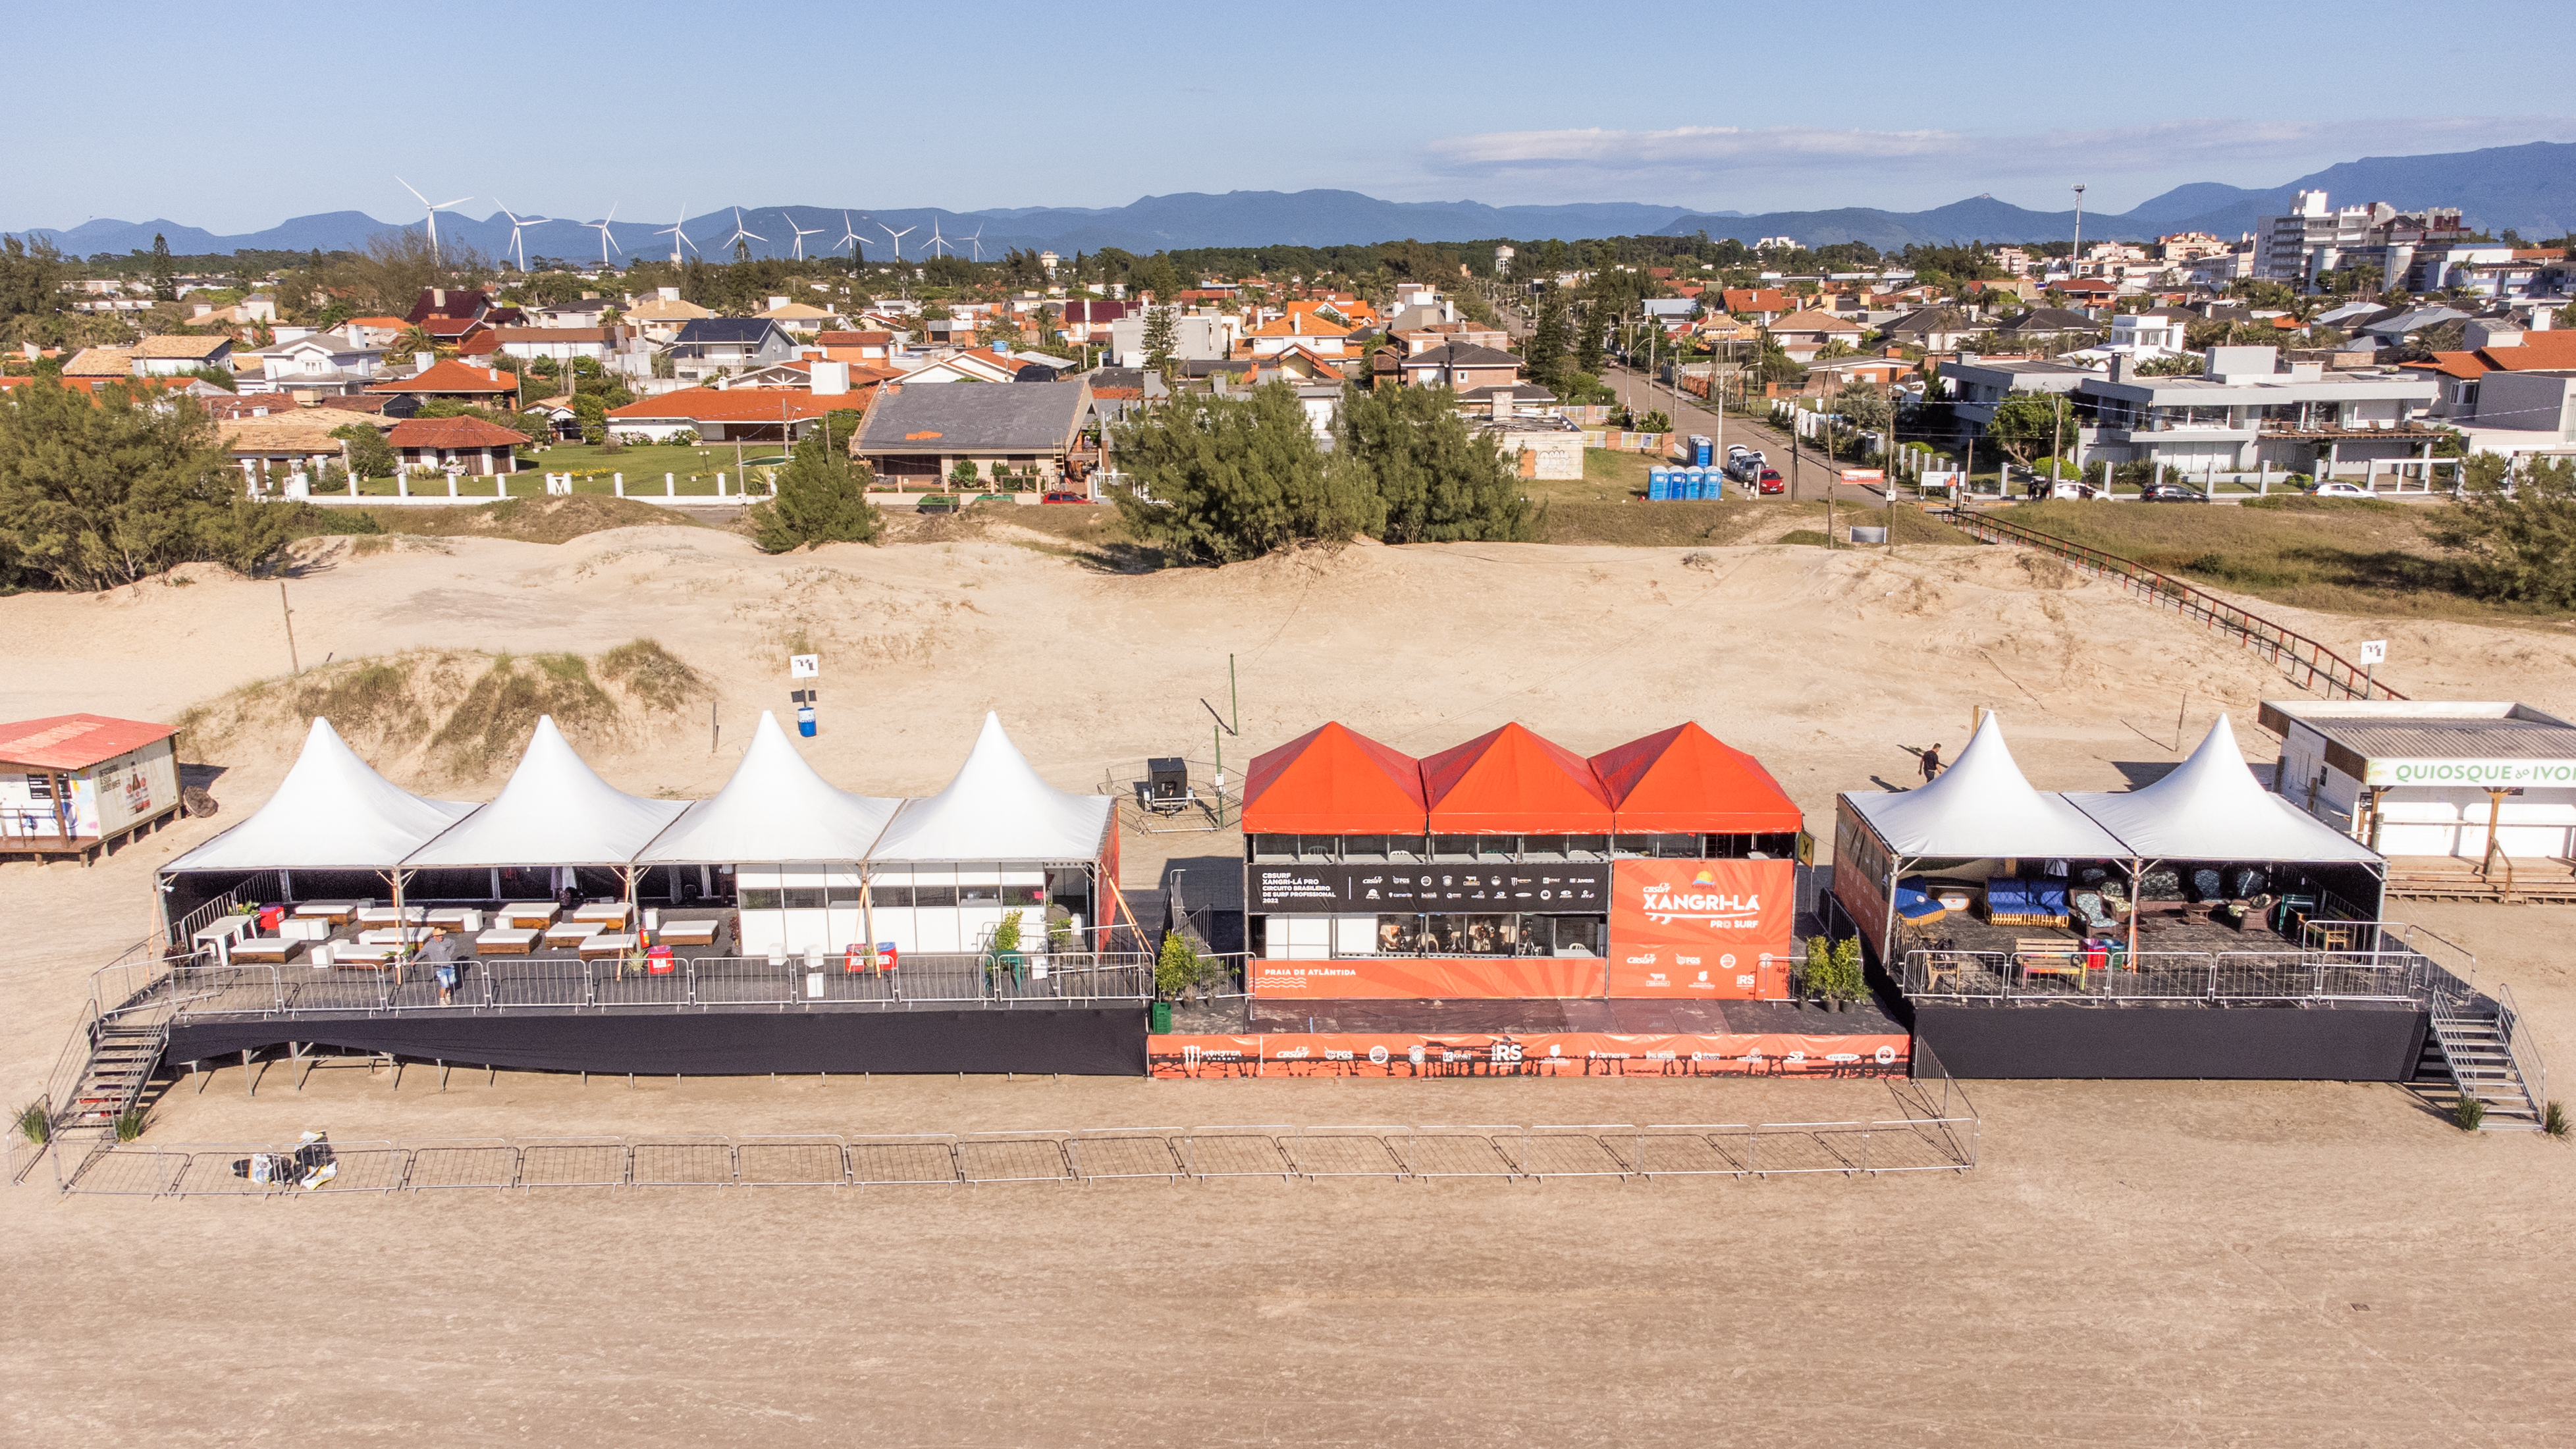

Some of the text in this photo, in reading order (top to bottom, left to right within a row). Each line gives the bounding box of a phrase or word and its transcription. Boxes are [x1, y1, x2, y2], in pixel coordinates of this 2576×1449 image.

[2396, 764, 2576, 783] QUIOSQUE da IVO
[1643, 893, 1760, 910] XANGRI-LÁ
[1711, 920, 1731, 928] PRO
[1496, 1044, 1522, 1061] RS
